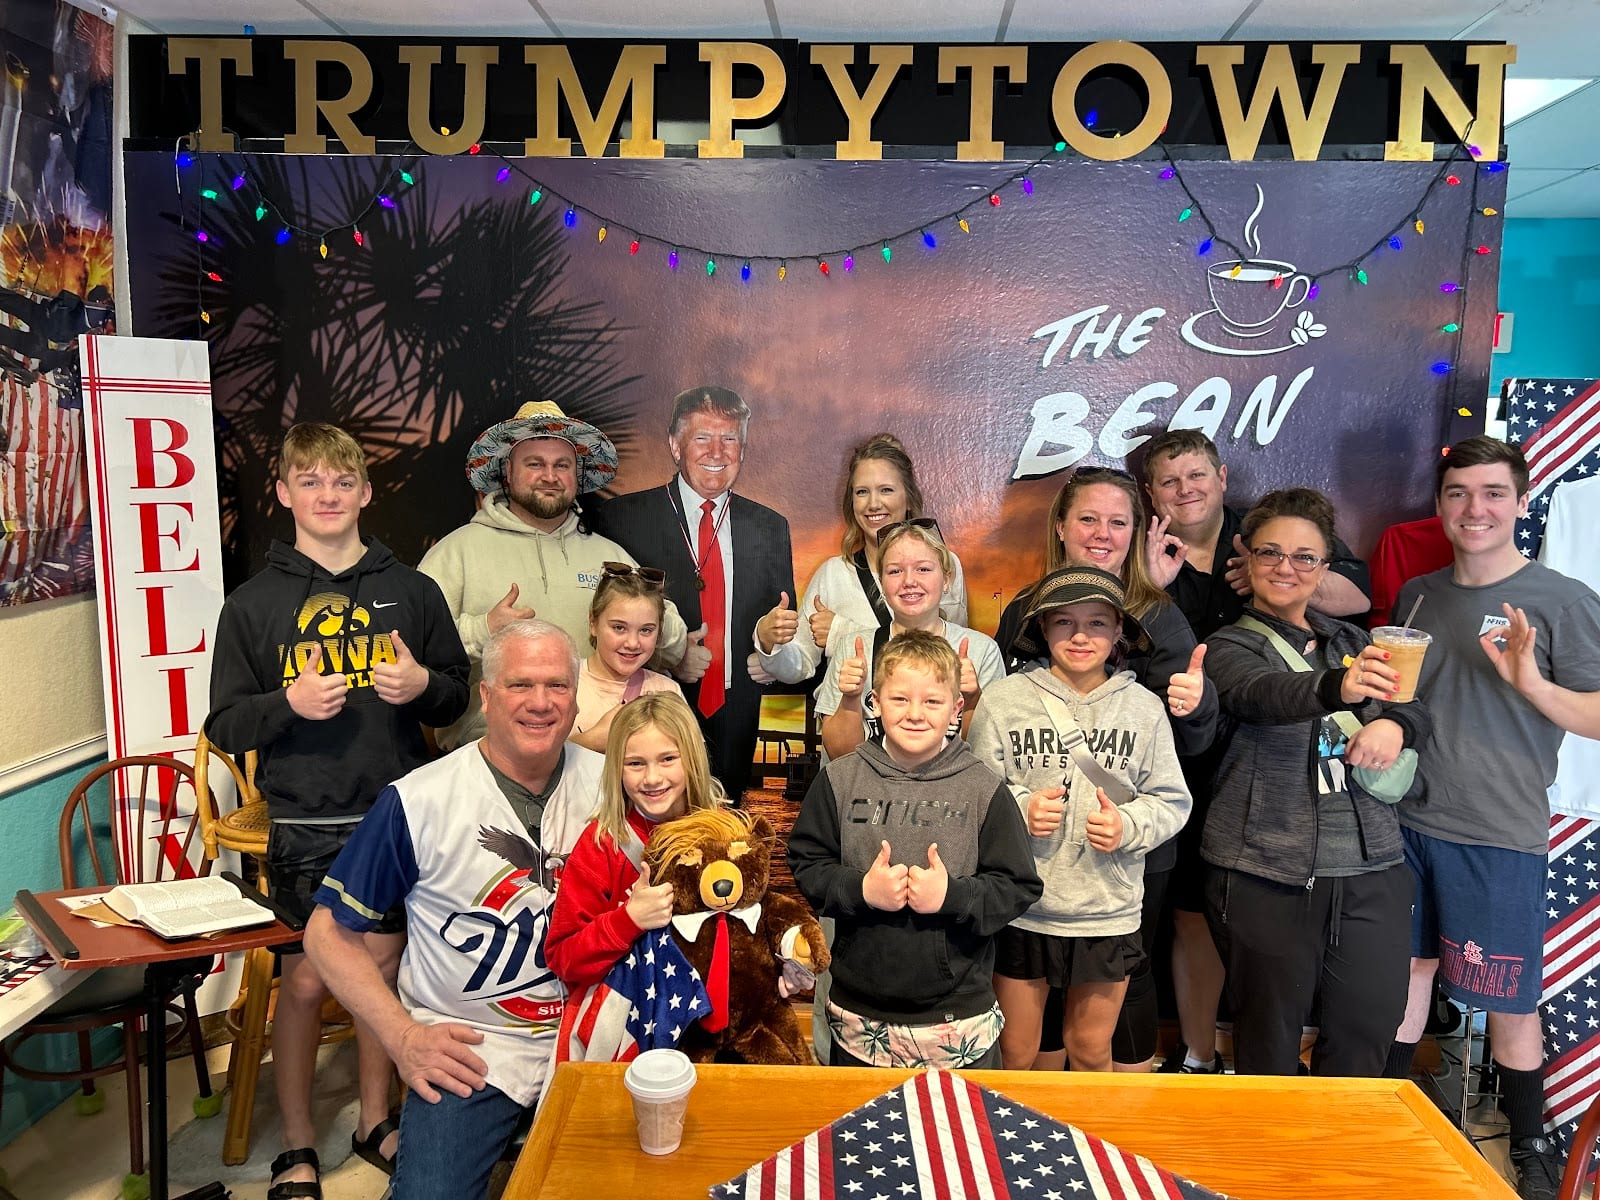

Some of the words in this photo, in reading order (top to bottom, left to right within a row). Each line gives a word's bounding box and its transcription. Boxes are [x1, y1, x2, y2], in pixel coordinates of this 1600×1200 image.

[167, 38, 1518, 162] TRUMPYTOWN
[1033, 304, 1167, 369] THE
[1012, 366, 1315, 480] BEAN
[577, 573, 600, 584] BUS
[125, 417, 226, 975] BELIE
[1008, 728, 1138, 757] BARRIAN
[1014, 754, 1130, 771] WRESNG
[1444, 948, 1523, 998] RDINALS
